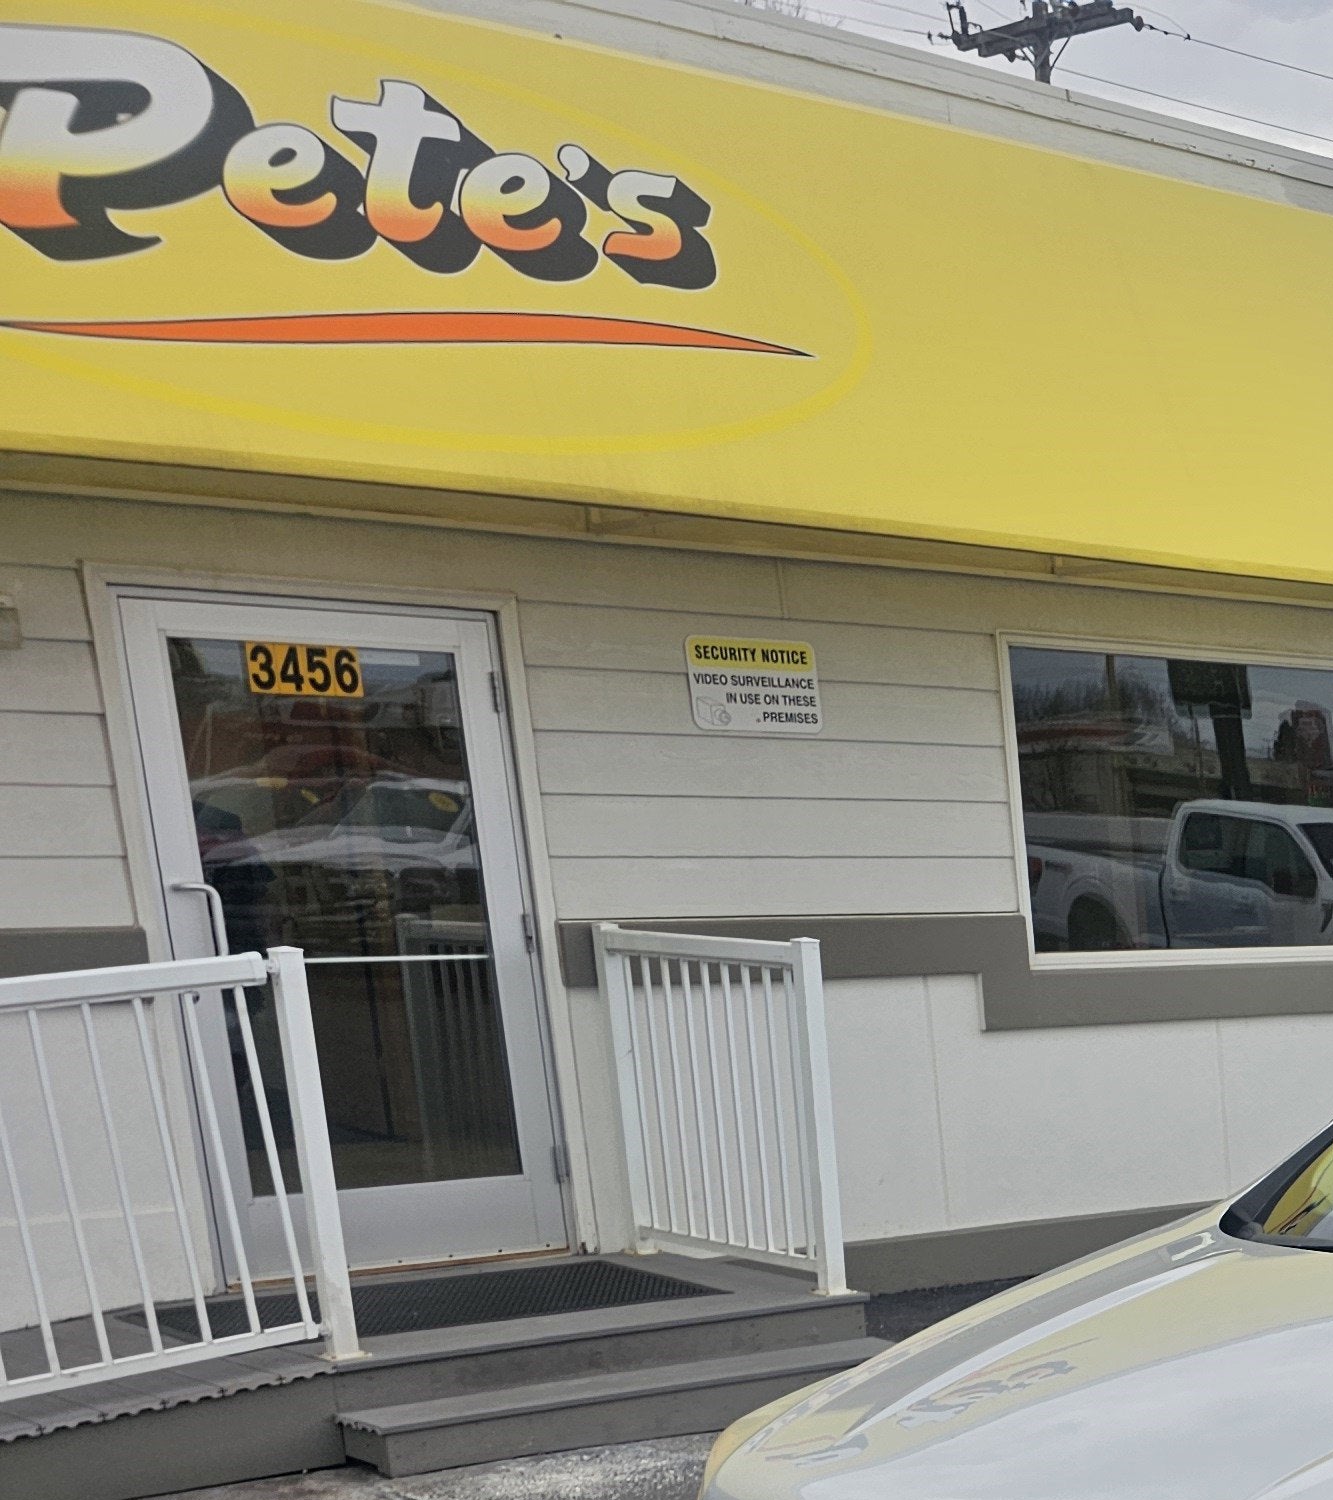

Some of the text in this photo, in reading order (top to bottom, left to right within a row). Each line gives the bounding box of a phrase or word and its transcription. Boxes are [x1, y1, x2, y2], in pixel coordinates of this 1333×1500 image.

[0, 25, 690, 275] Pete's
[694, 645, 808, 665] SECURITY NOTICE
[250, 645, 359, 693] 3456
[693, 673, 815, 690] VIDEO SURVEILLANCE
[726, 692, 817, 707] IN USE ON THESE
[763, 712, 818, 725] PREMISES
